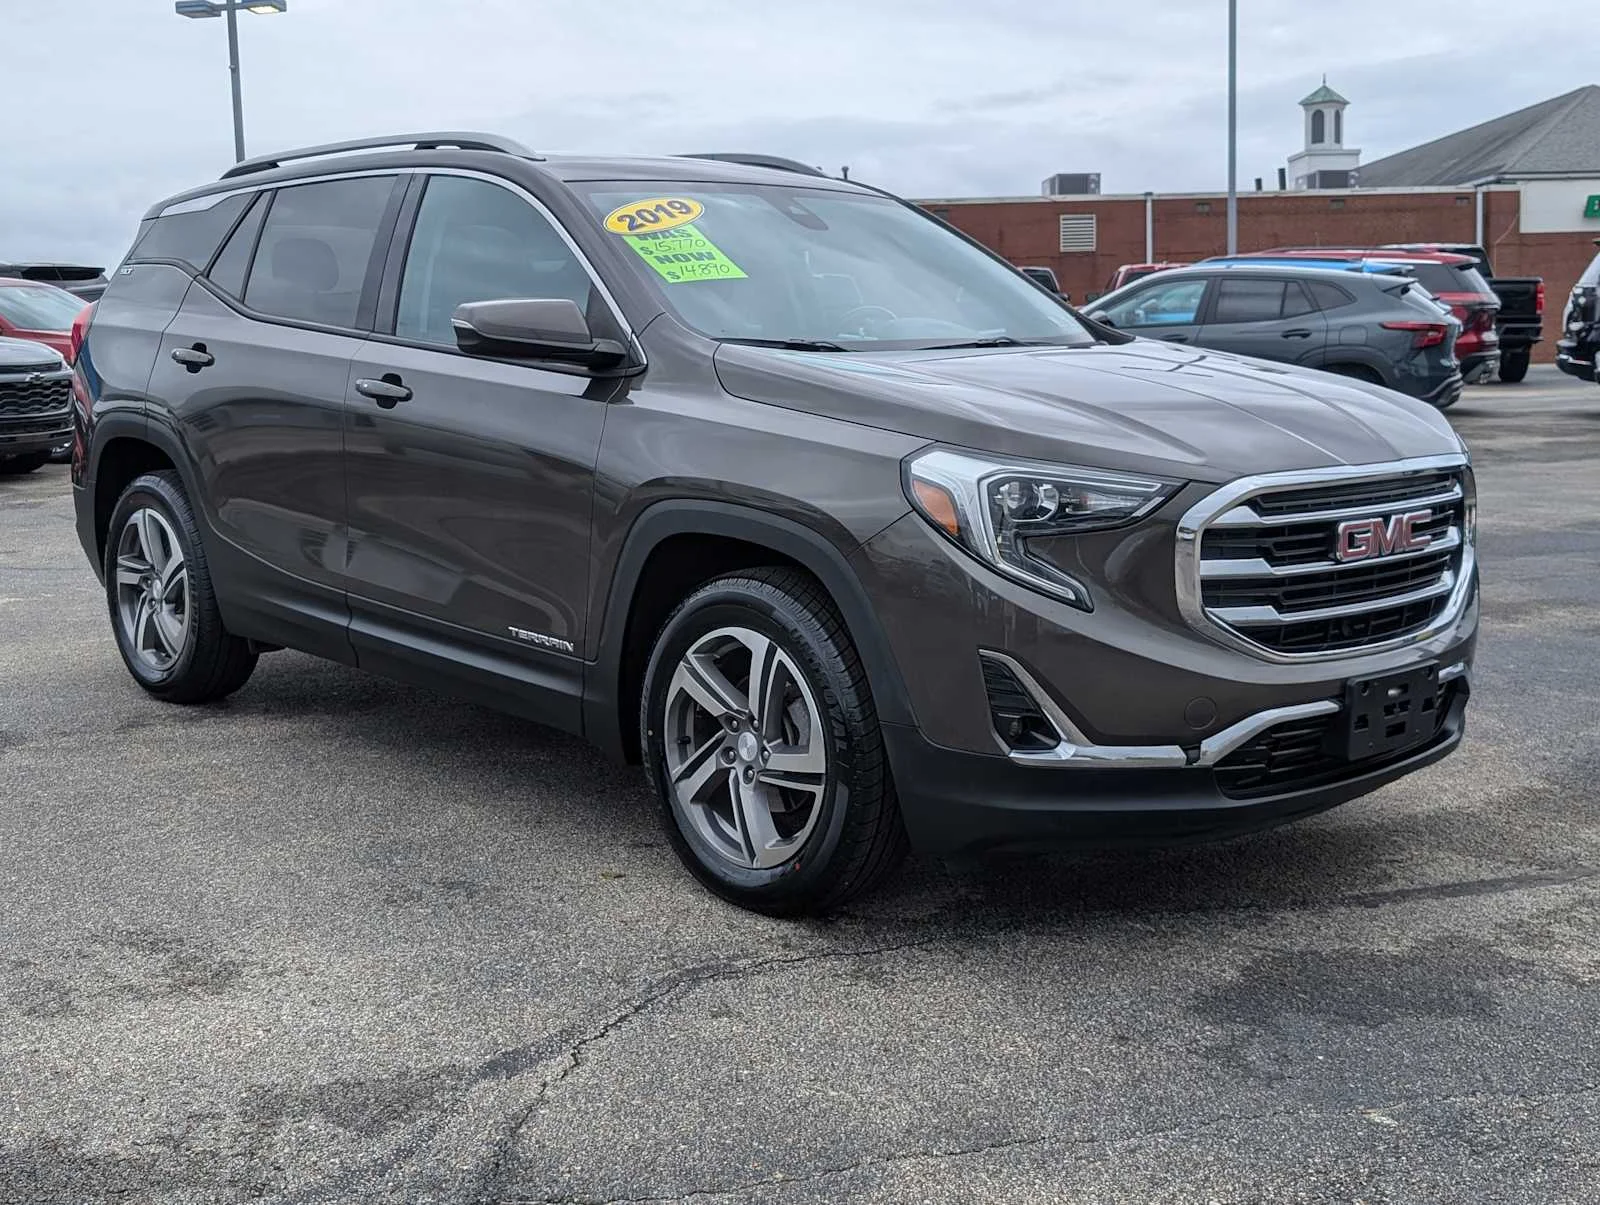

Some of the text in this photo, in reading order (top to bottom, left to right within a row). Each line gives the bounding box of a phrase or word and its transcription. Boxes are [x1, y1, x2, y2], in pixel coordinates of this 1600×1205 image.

[617, 200, 692, 231] 2019
[653, 251, 716, 264] NOW
[1337, 509, 1433, 562] GMC
[508, 626, 574, 652] TERRAIN
